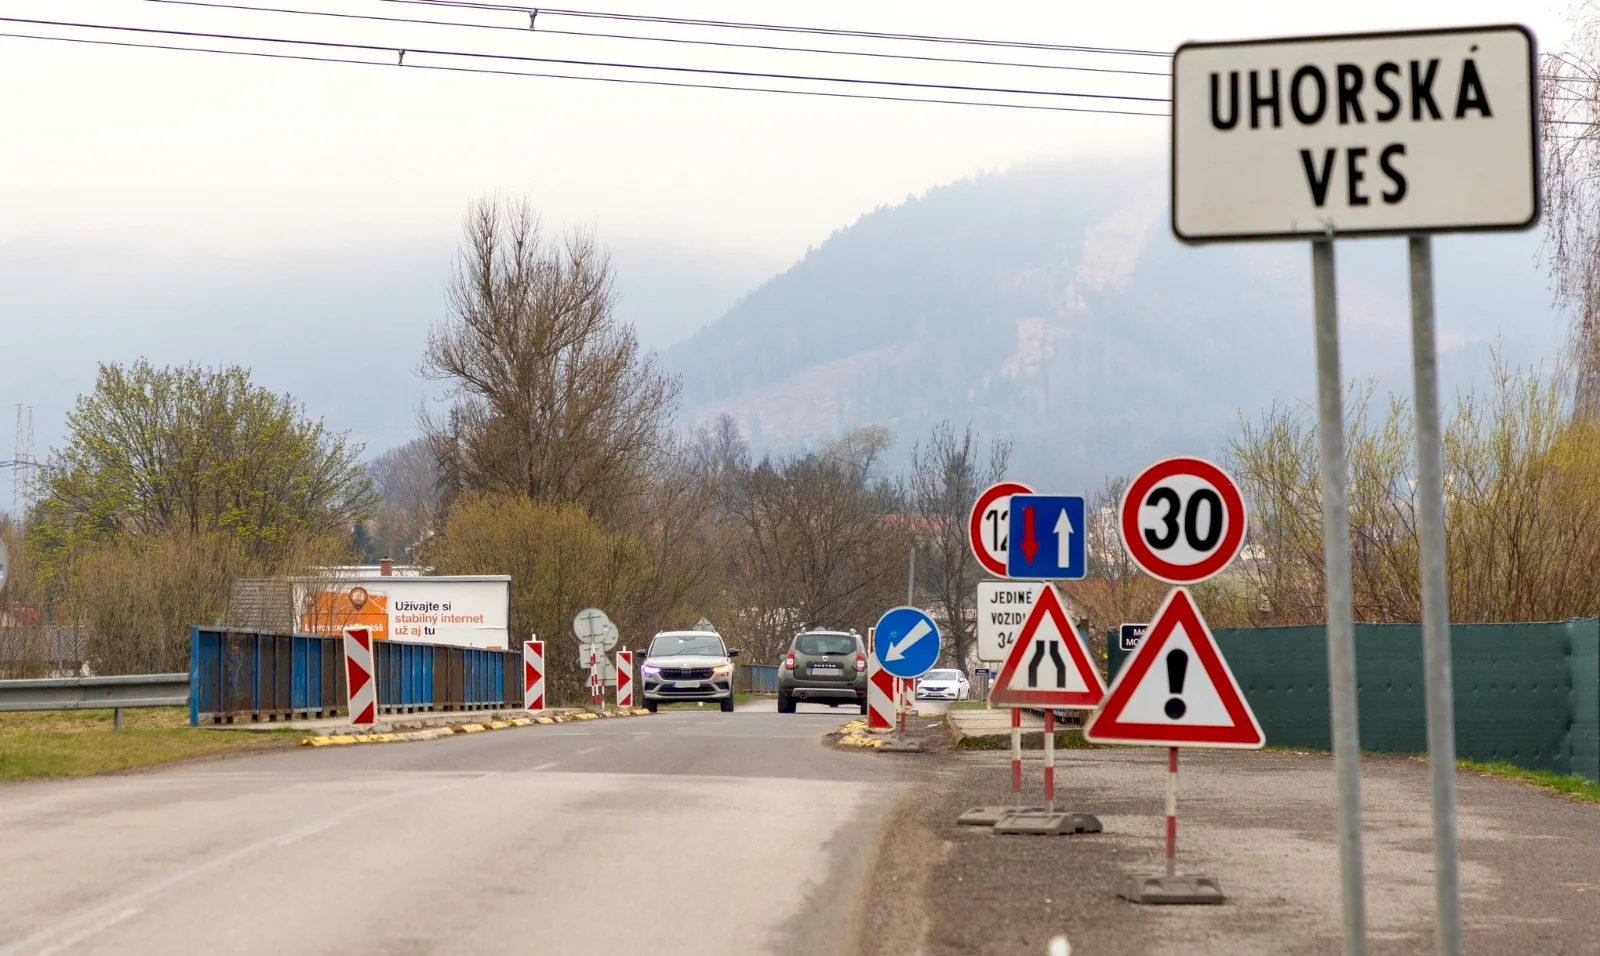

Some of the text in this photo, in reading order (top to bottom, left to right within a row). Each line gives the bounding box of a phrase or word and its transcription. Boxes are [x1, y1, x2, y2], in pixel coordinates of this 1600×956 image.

[1210, 44, 1494, 131] UHORSKÁ
[1299, 143, 1408, 208] VES
[1144, 486, 1223, 552] 30
[990, 588, 1033, 604] JEDINÉ
[395, 601, 452, 613] Užívajte si
[395, 613, 484, 625] stabilný internet
[395, 626, 435, 637] už aj tu
